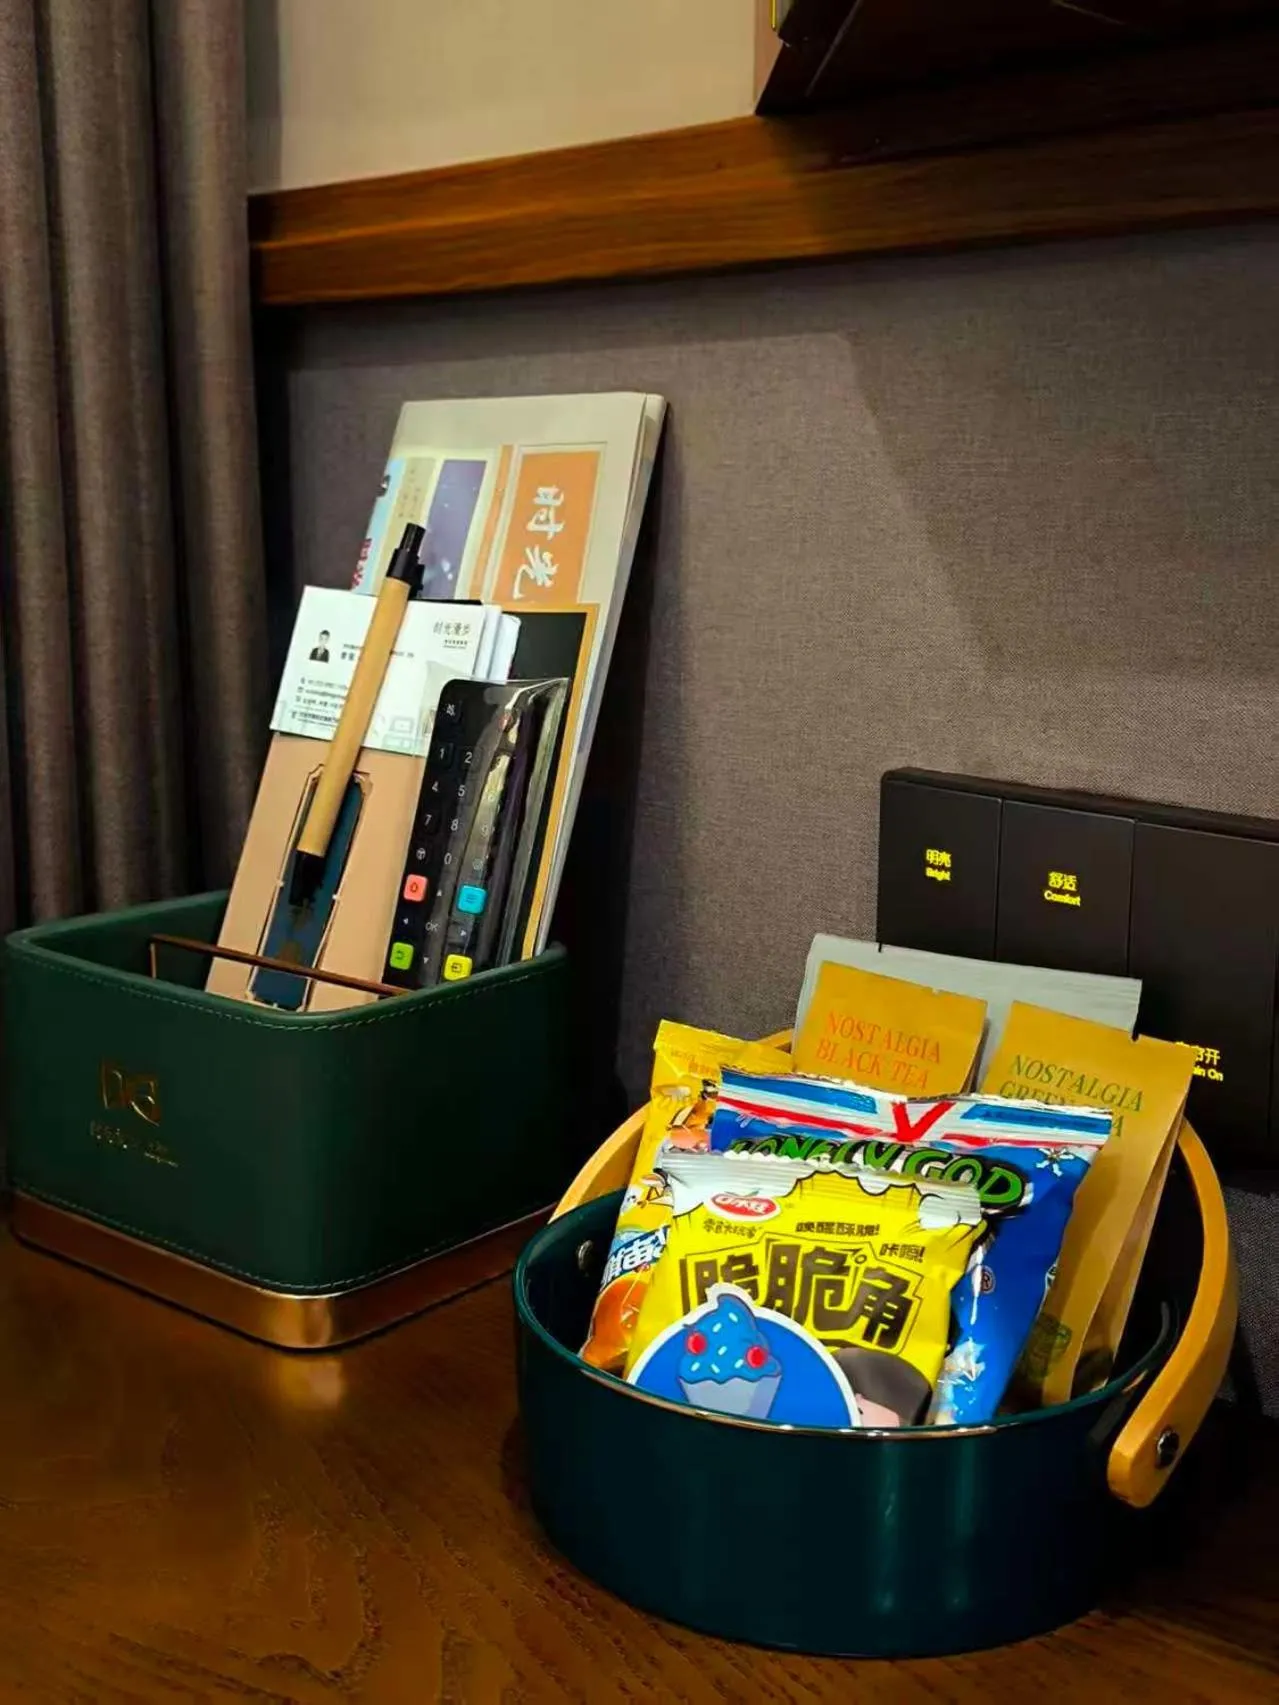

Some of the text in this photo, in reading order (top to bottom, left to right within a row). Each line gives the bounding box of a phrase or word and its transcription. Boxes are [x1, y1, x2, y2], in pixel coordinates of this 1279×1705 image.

[439, 748, 473, 764] 1 2
[431, 781, 440, 793] 4
[457, 784, 466, 797] 5
[424, 814, 432, 826] 7
[450, 818, 459, 832] 8
[443, 852, 453, 866] 0
[925, 848, 952, 868] 明亮
[1048, 871, 1077, 892] 舒适
[1044, 890, 1081, 907] Comfort
[425, 921, 439, 933] OK
[827, 1012, 942, 1064] NOSTALGIA
[816, 1038, 930, 1090] BLACK TEA
[1010, 1054, 1145, 1113] NOSTALGIA
[1207, 1069, 1224, 1081] On
[900, 1148, 1027, 1207] GOD
